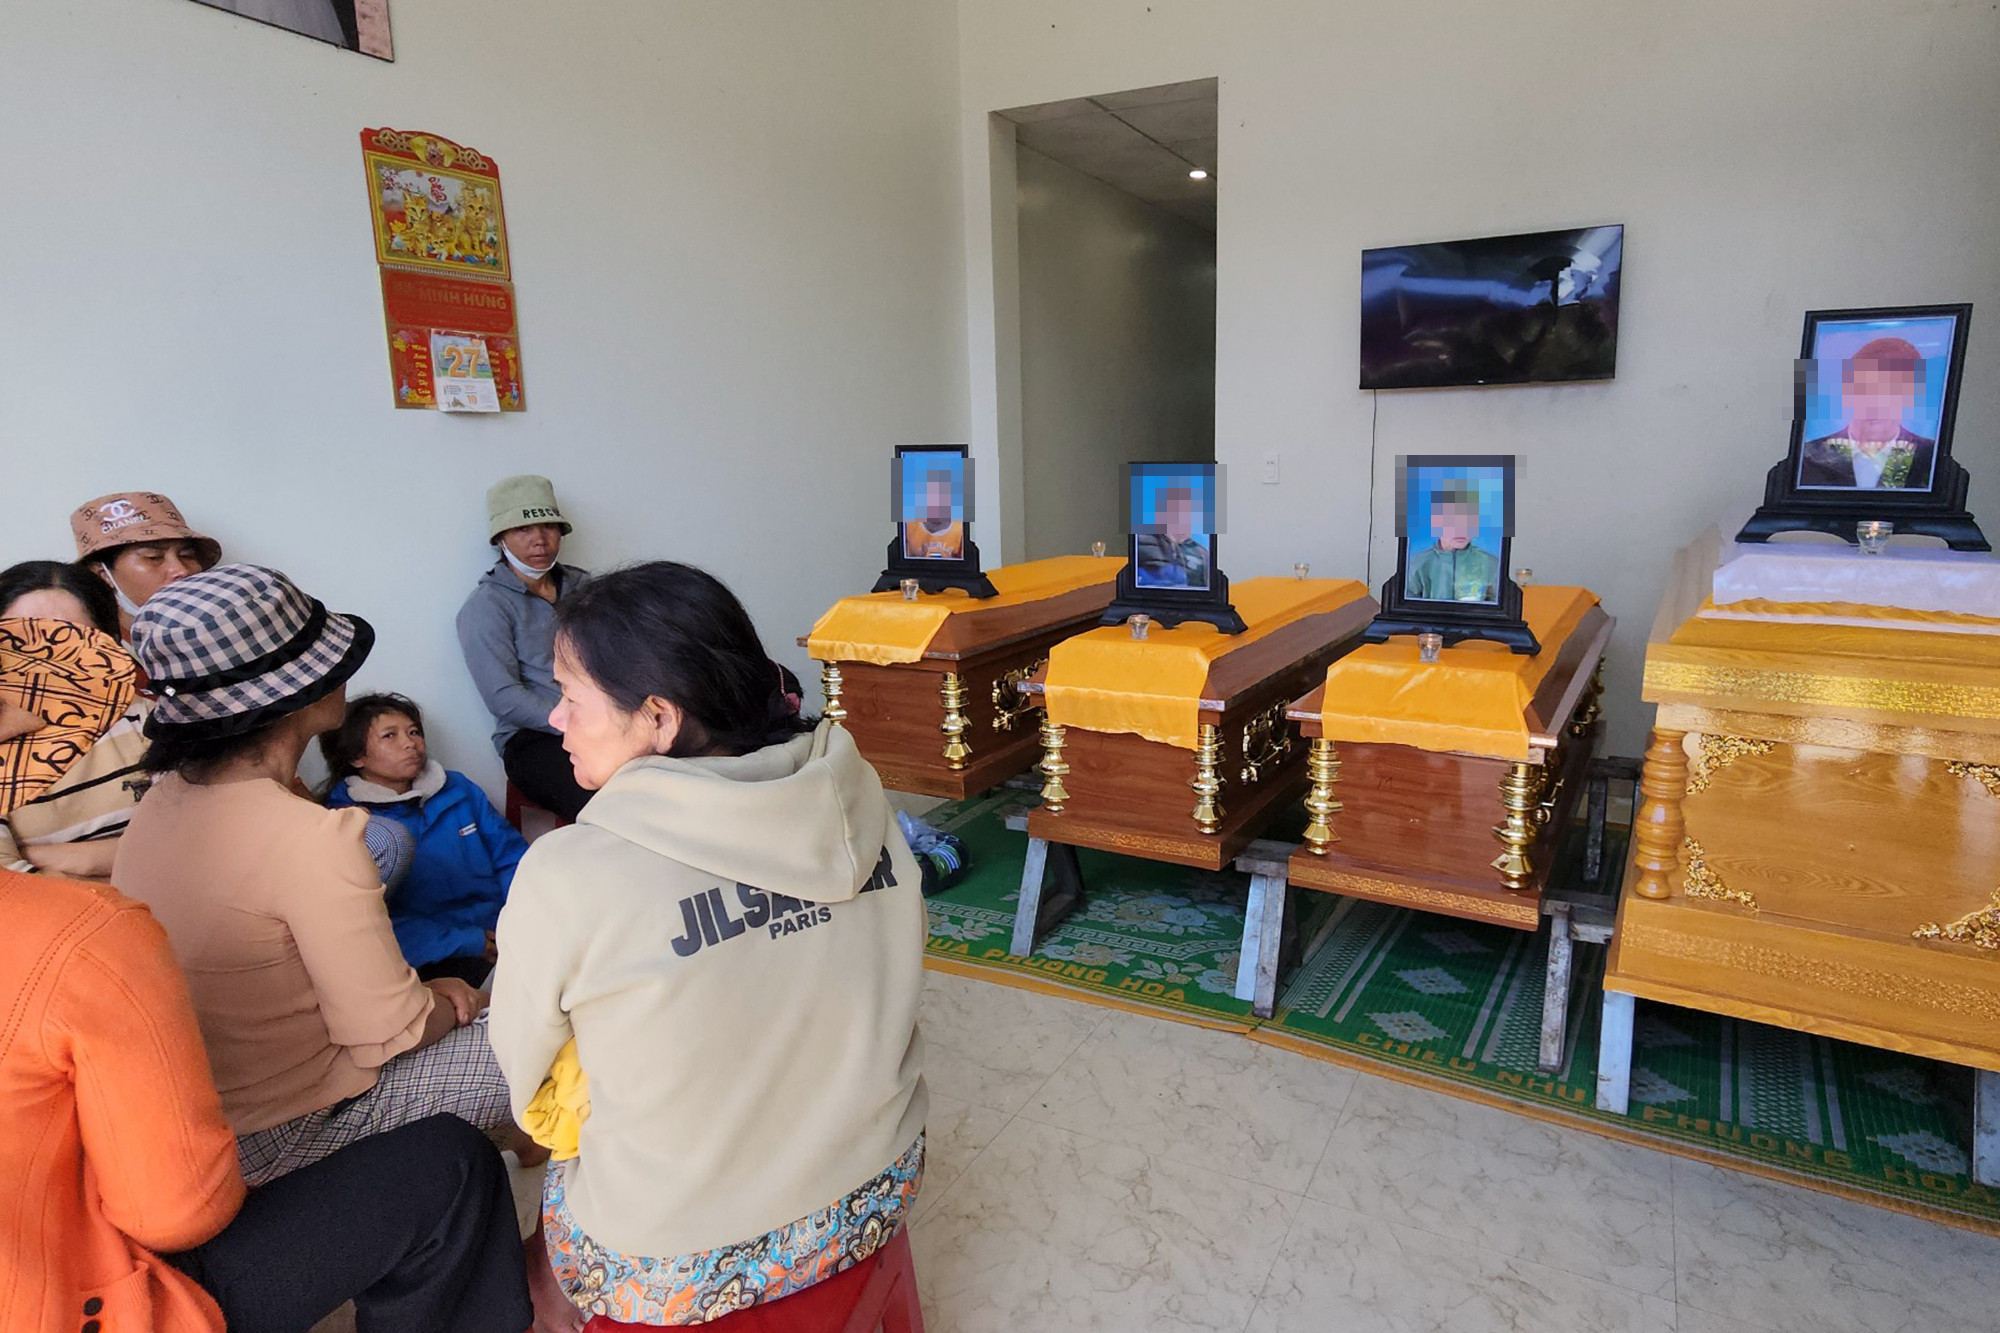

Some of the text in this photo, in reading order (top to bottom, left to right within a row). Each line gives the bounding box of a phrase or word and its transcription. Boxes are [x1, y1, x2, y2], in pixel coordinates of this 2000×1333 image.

[444, 345, 481, 378] 27
[102, 515, 145, 534] CHANEL
[768, 906, 832, 940] PARIS
[1118, 977, 1185, 1002] HOA
[1497, 1071, 1586, 1102] NHU
